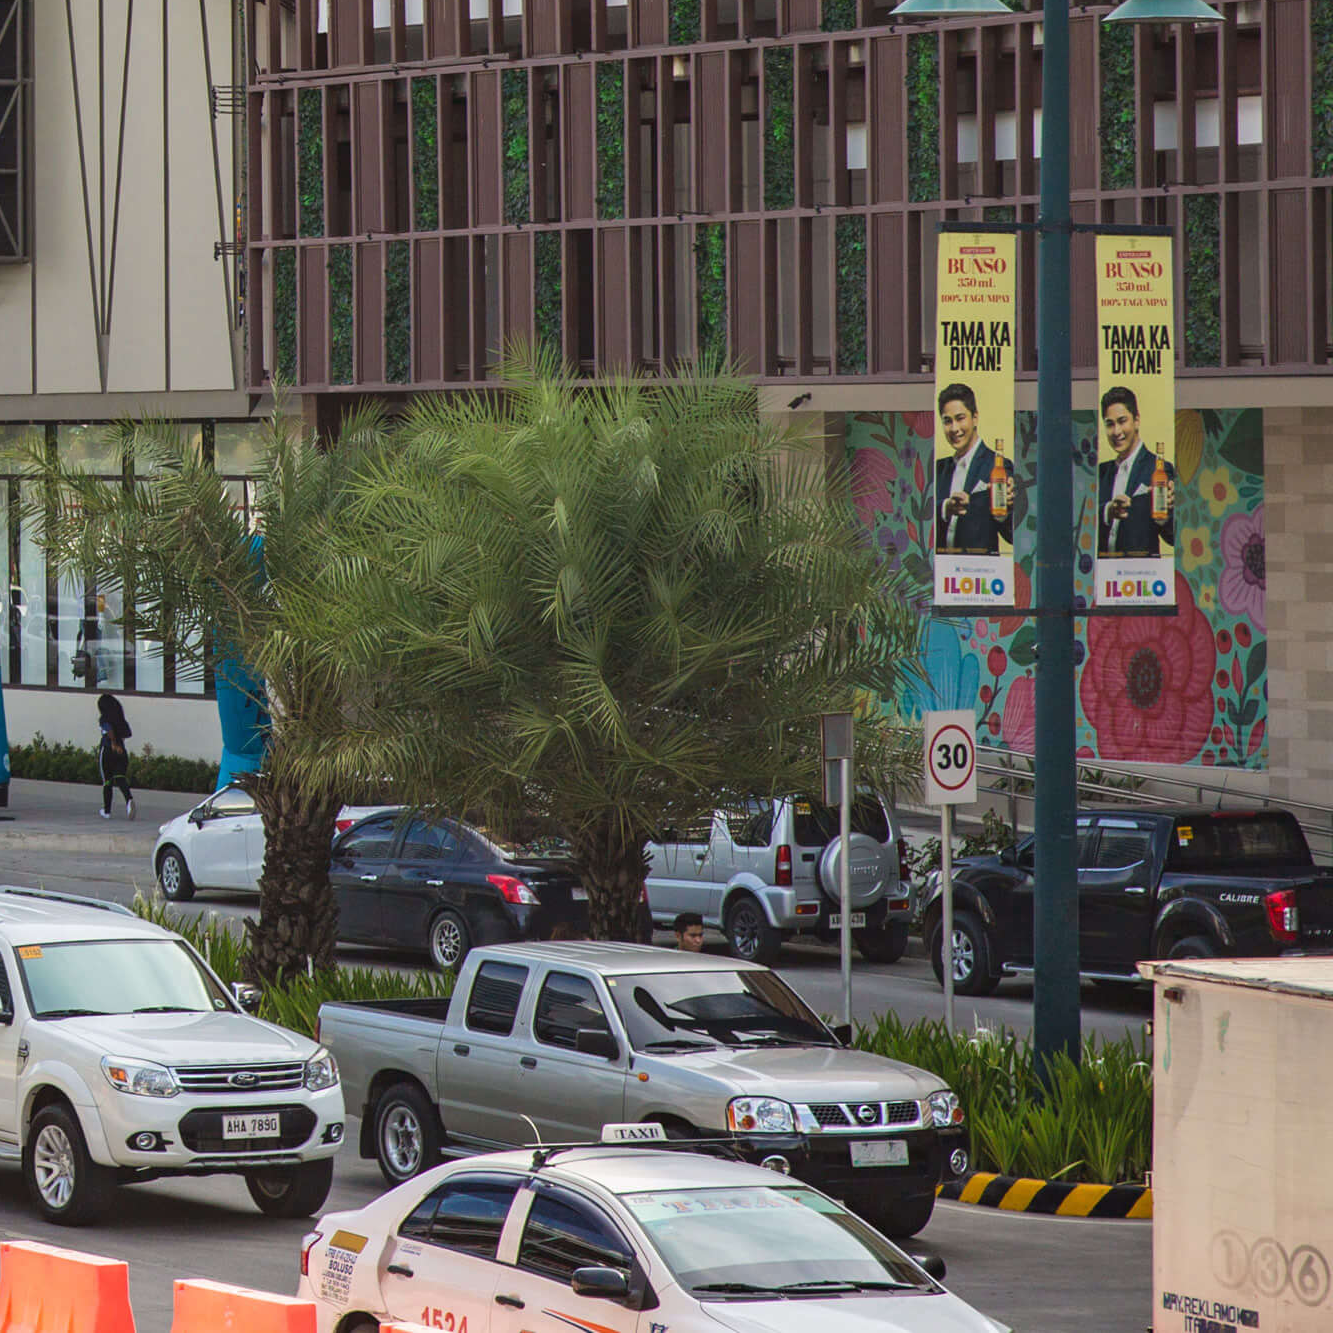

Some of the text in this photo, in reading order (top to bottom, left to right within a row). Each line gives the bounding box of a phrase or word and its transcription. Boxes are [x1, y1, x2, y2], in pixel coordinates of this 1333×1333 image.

[947, 257, 1007, 274] BUNSO
[1105, 262, 1163, 278] BUNSO
[941, 321, 1011, 346] TAMA KA
[1102, 325, 1171, 350] TAMA KA
[950, 346, 1001, 371] DIYAN!
[1112, 350, 1161, 374] DIYAN!
[943, 576, 1005, 596] ILOILO
[1105, 580, 1167, 597] ILOILO
[937, 743, 968, 770] 30
[1219, 893, 1260, 904] CALIBRE
[227, 1120, 246, 1133] AHA
[618, 1127, 657, 1139] TAXI
